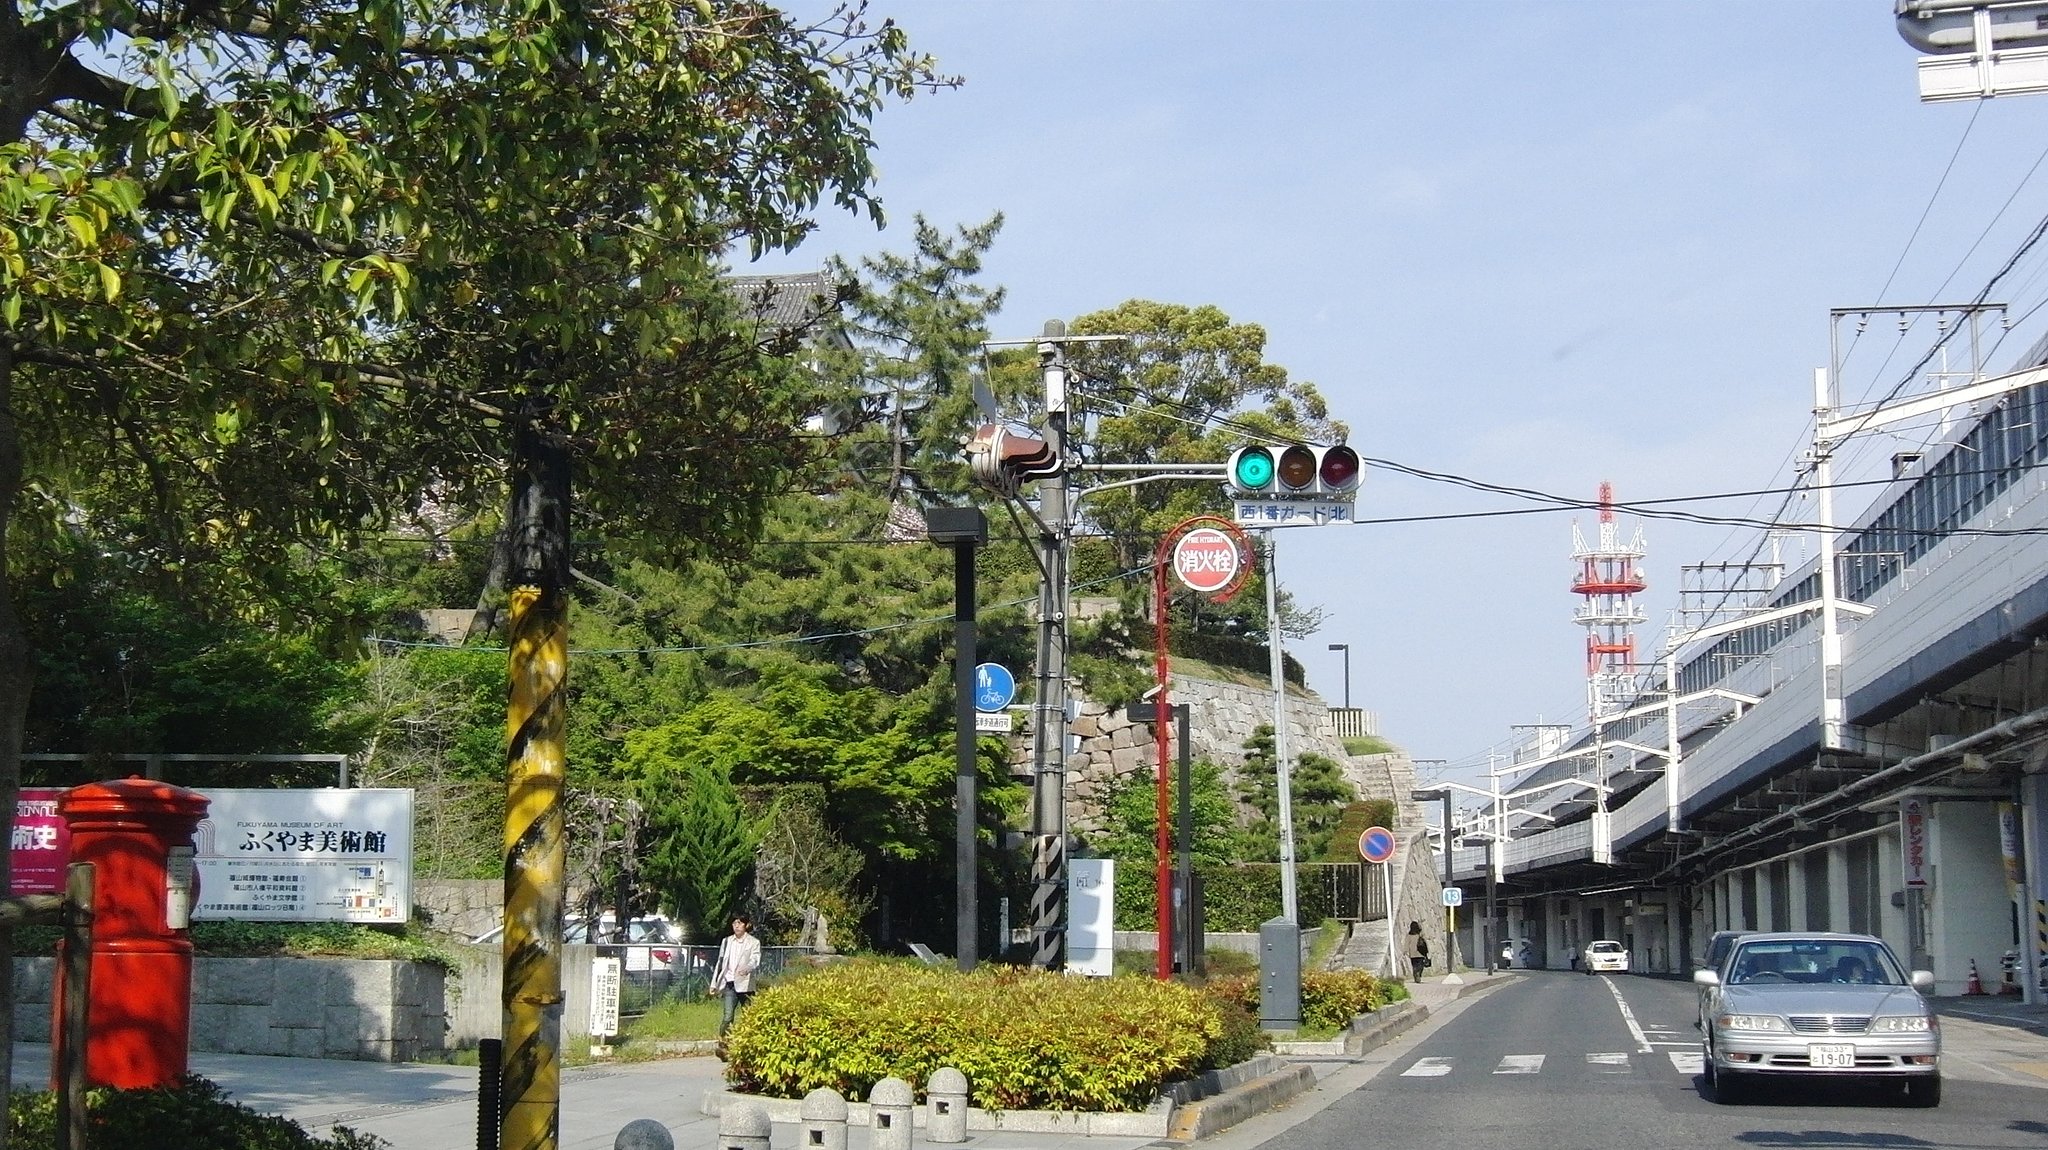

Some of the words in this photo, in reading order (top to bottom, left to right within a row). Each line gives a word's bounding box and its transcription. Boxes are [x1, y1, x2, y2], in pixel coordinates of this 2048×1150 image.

[1241, 504, 1348, 520] 西1番ガード(北)
[1180, 549, 1232, 573] 消火栓
[240, 831, 387, 853] ふくやま美術館
[1446, 891, 1458, 900] 13
[604, 964, 617, 1030] 無断駐車禁止
[1821, 1054, 1852, 1064] 19-07
